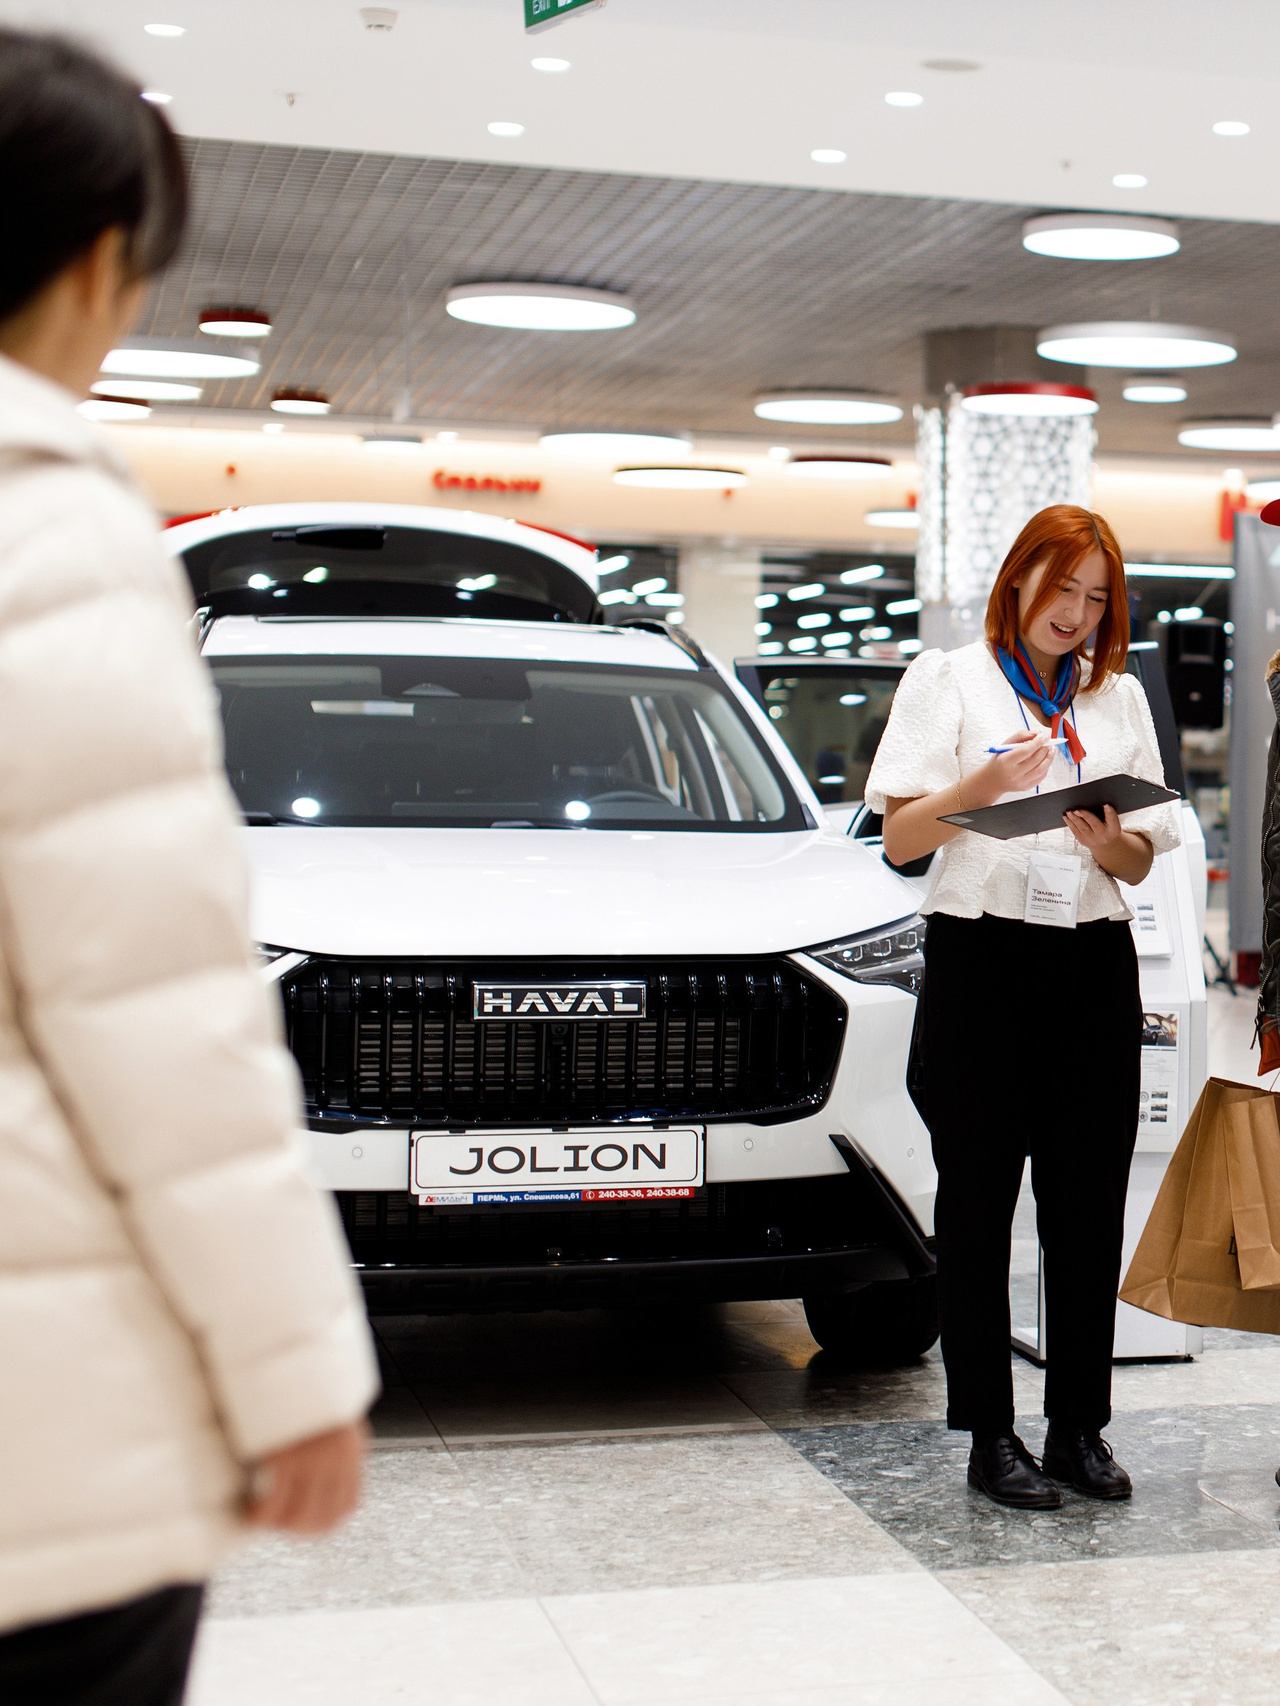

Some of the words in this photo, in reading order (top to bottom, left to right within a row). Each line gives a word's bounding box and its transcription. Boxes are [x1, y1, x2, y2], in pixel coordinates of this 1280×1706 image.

[1032, 888, 1063, 898] Тамара
[1031, 895, 1072, 906] Зеленина
[483, 991, 639, 1013] HAVAL
[449, 1143, 666, 1176] JOLION
[477, 1194, 508, 1203] ПЕРМЬ,
[510, 1195, 522, 1203] ул.
[598, 1189, 644, 1199] 240-38-36,
[646, 1188, 690, 1197] 240-38-68
